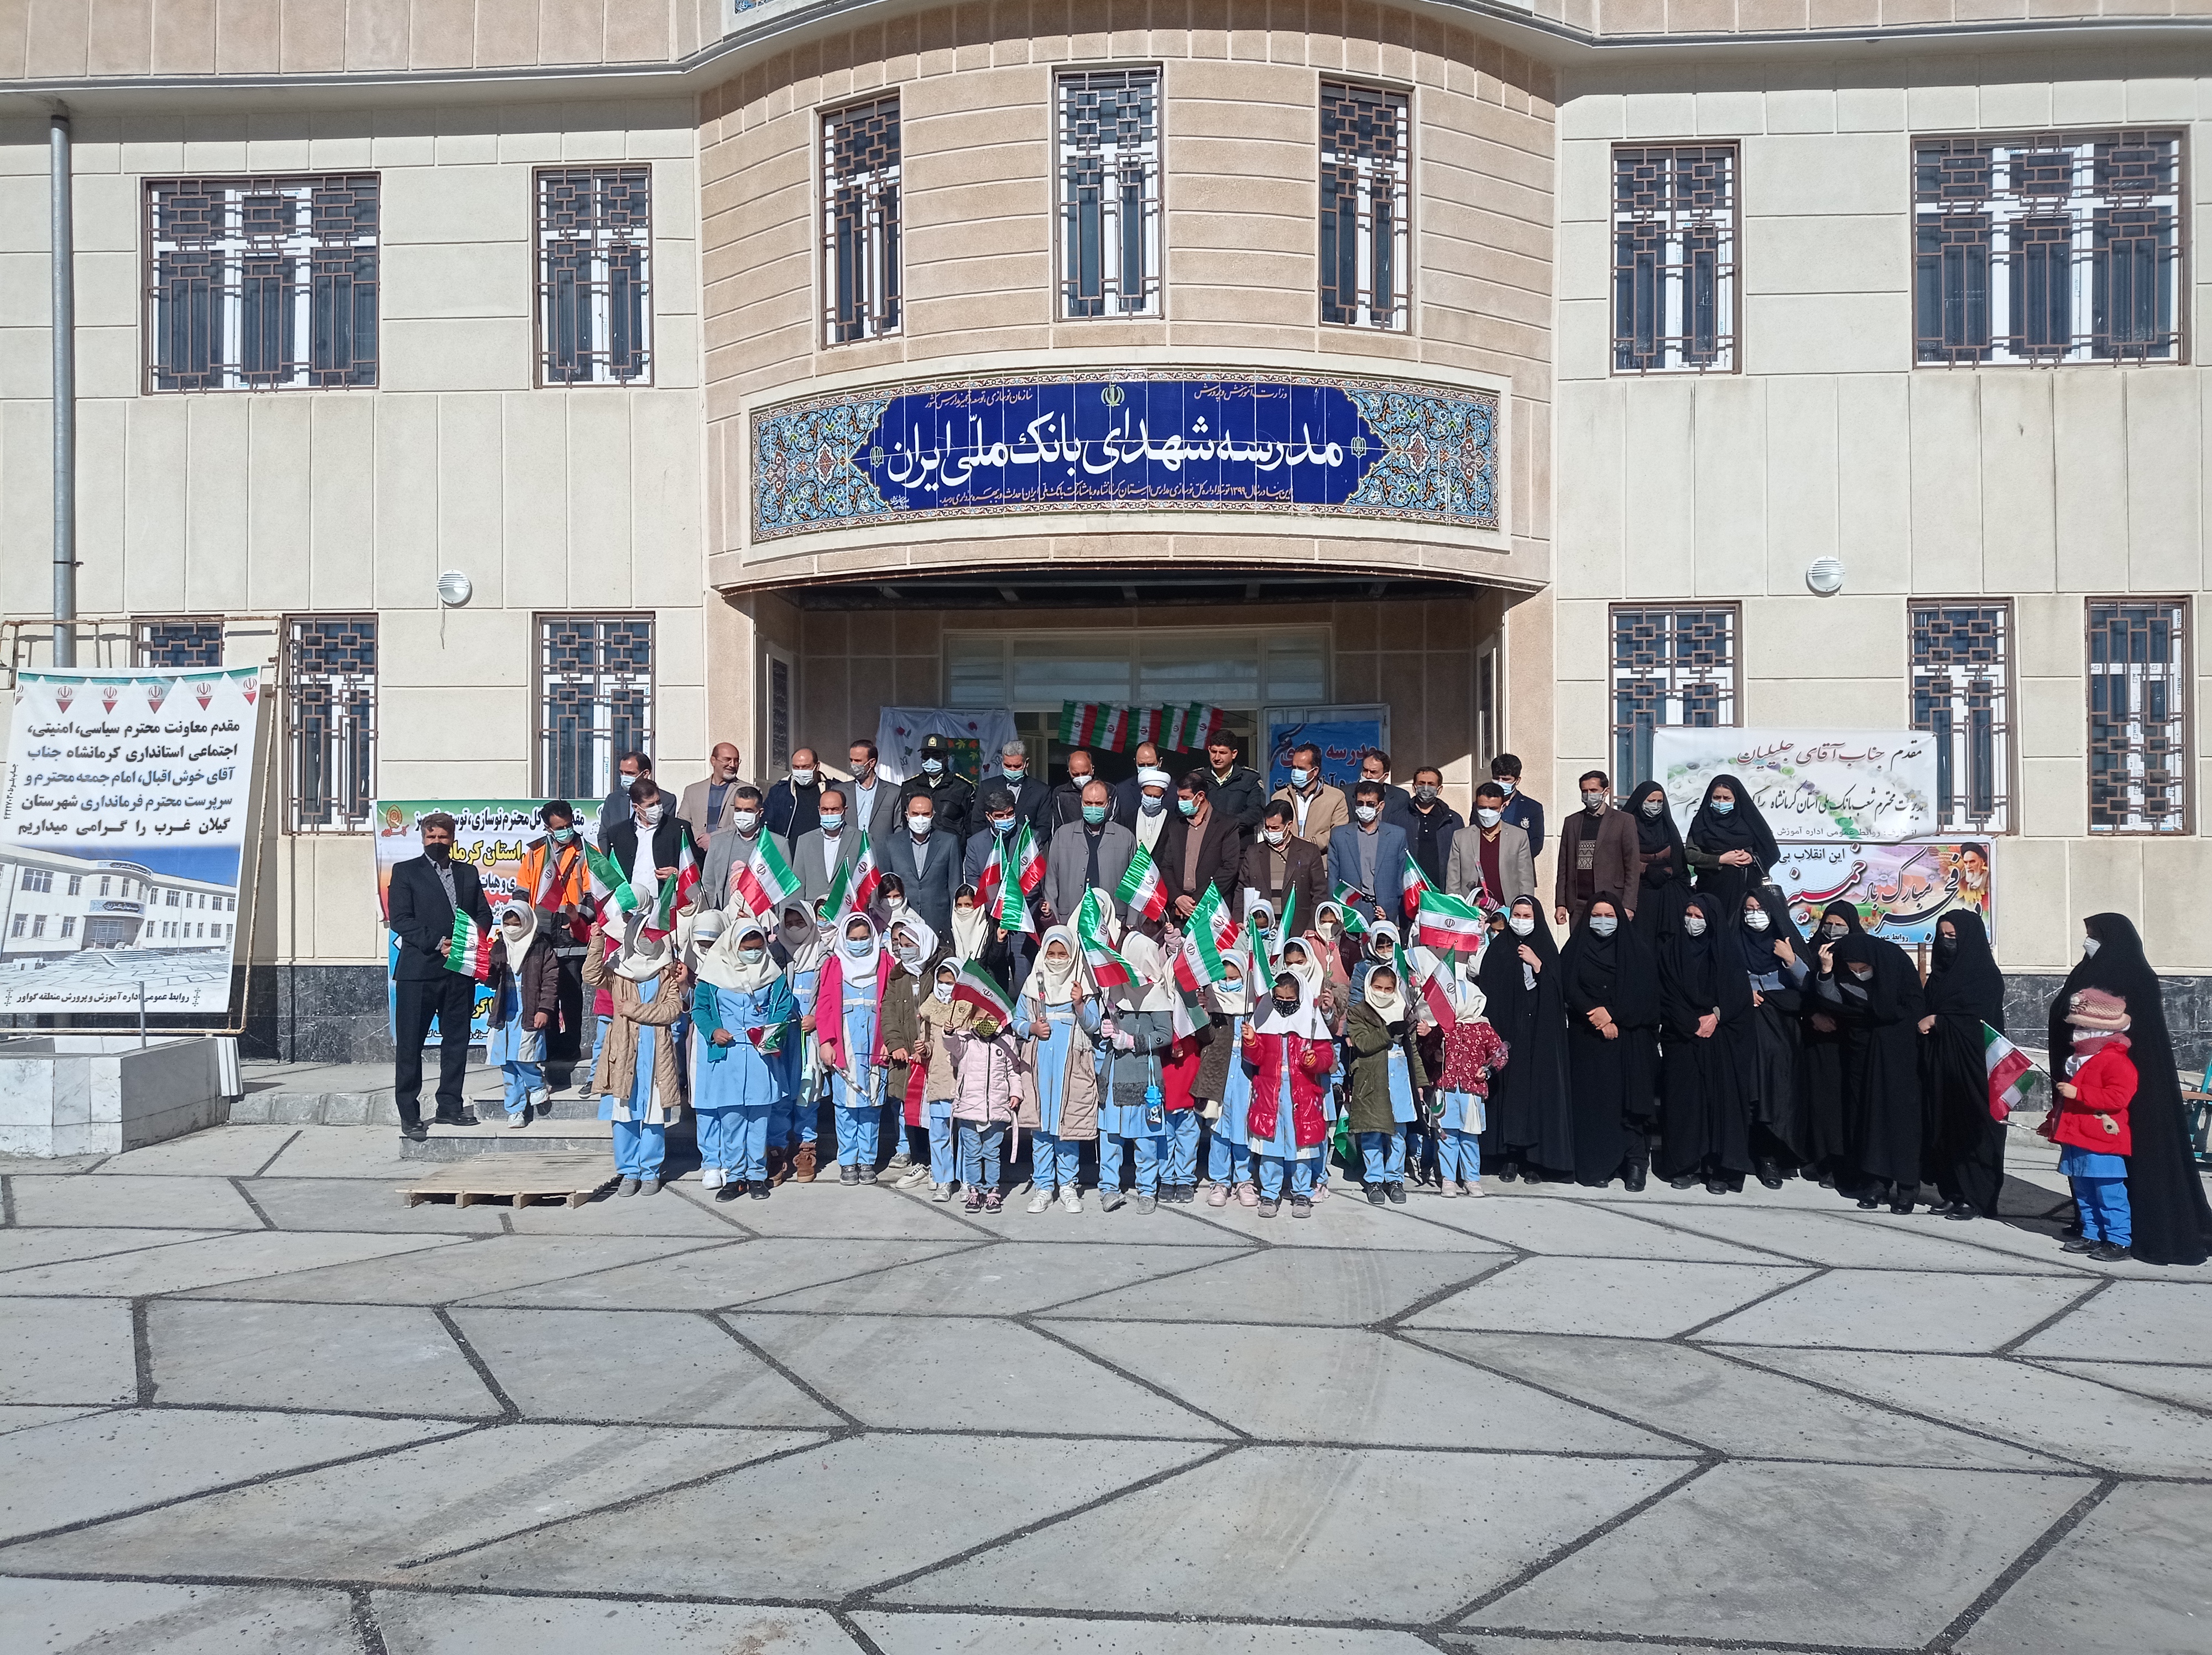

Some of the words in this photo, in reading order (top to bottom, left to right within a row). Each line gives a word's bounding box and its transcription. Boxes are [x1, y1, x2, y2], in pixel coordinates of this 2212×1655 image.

[1194, 383, 1221, 402] پرورش
[1224, 384, 1255, 400] آموزش
[1253, 387, 1287, 399] وزارت
[1010, 410, 1082, 477] بانک
[1082, 407, 1215, 474] شهدای
[1217, 423, 1343, 471] مدرسه
[887, 420, 951, 492] ایران
[1150, 483, 1170, 497] مدارس
[1230, 486, 1245, 496] ۱۳۹۹
[28, 722, 73, 737] امنیتی،
[75, 721, 120, 737] سیاسی،
[124, 724, 160, 737] محترم
[165, 721, 207, 737] معاونت
[211, 720, 239, 736] مقدم
[28, 746, 61, 761] جناب
[66, 746, 121, 762] کرمانشاه
[126, 746, 184, 762] استانداری
[189, 743, 238, 761] اجتماعی
[1736, 740, 1794, 770] جلیلیان
[1797, 742, 1845, 766] آقای
[1839, 747, 1885, 770] جناب
[1891, 740, 1922, 771] مقدم
[24, 775, 33, 786] و
[34, 772, 75, 786] محترم
[76, 773, 109, 787] جمعه
[112, 771, 135, 787] امام
[138, 769, 171, 786] اقبال،
[173, 769, 205, 786] خوش
[207, 766, 236, 785] آقای
[22, 794, 78, 811] شهرستان
[81, 794, 143, 811] فرمانداری
[1771, 780, 1807, 809] کرمانشاه
[1834, 783, 1857, 820] بانک
[145, 797, 181, 811] محترم
[185, 797, 232, 810] سرپرست
[1798, 794, 1818, 814] استان
[1875, 792, 1896, 822] محترم
[1895, 799, 1923, 821] مدیریت
[18, 819, 67, 835] میداریم
[76, 819, 128, 836] گرامی
[136, 820, 146, 836] را
[155, 819, 191, 836] غرب
[199, 818, 231, 834] گیلان
[503, 811, 528, 831] محترم
[1777, 826, 1803, 837] آموزش
[1806, 828, 1823, 837] اداره
[1827, 829, 1855, 837] عمومی
[1859, 829, 1880, 838] روابط
[1911, 829, 1917, 837] از
[482, 839, 522, 867] استان
[1794, 848, 1825, 862] انقلاب
[1829, 848, 1845, 864] این
[1881, 846, 1932, 909] مبارک
[1891, 933, 1908, 943] روابط
[61, 992, 87, 1003] پرورش
[94, 991, 123, 1003] آموزش
[122, 992, 140, 1003] اداره
[144, 993, 167, 1002] عمومی
[169, 992, 190, 1003] روابط
